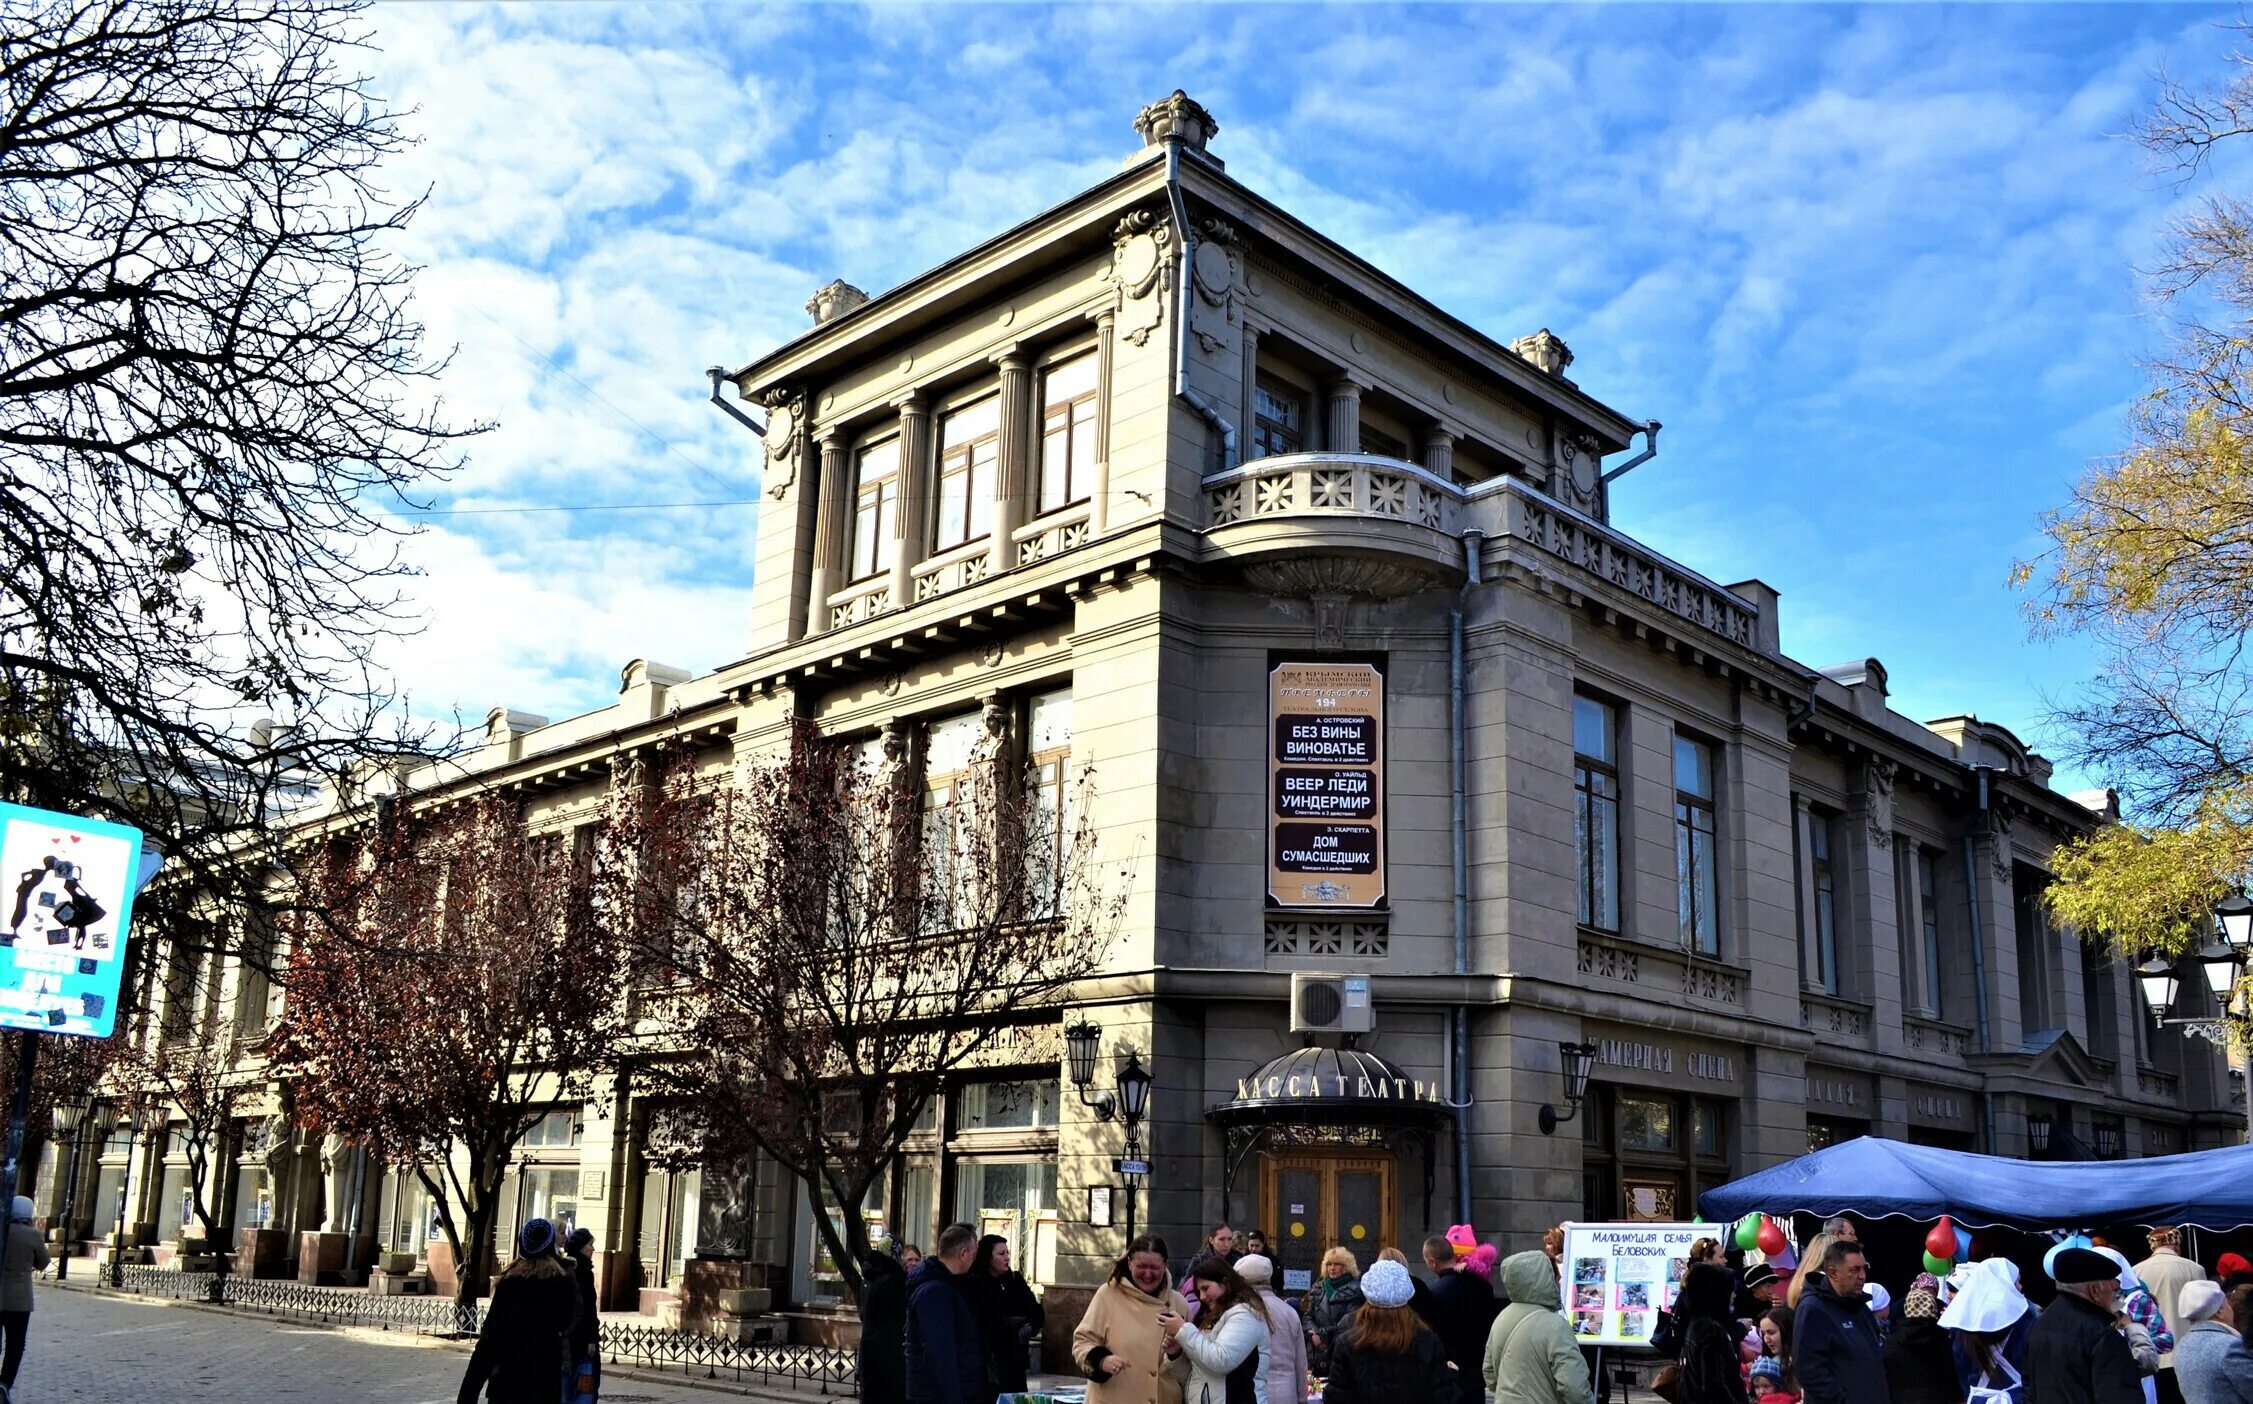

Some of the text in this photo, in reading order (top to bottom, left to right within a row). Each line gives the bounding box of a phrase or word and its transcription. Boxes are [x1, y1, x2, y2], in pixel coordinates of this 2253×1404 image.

[1316, 698, 1337, 707] 194
[1292, 725, 1361, 739] БЕЗ ВИНЫ
[1286, 741, 1366, 755] ВИНОВАТЬЕ
[1285, 777, 1367, 794] ВЕЕР ЛЕДИ
[1281, 794, 1371, 811] УИНДЕРМИР
[1334, 826, 1370, 834] СКАРПЕТТА
[1312, 836, 1338, 849] ДОМ
[1282, 850, 1370, 865] СУМАСШЕДШИХ
[1237, 1074, 1438, 1103] КАССА ТЕАТРА
[1664, 1233, 1693, 1244] СЕМЬЯ
[1612, 1245, 1666, 1257] БЕЛОВСКИХ
